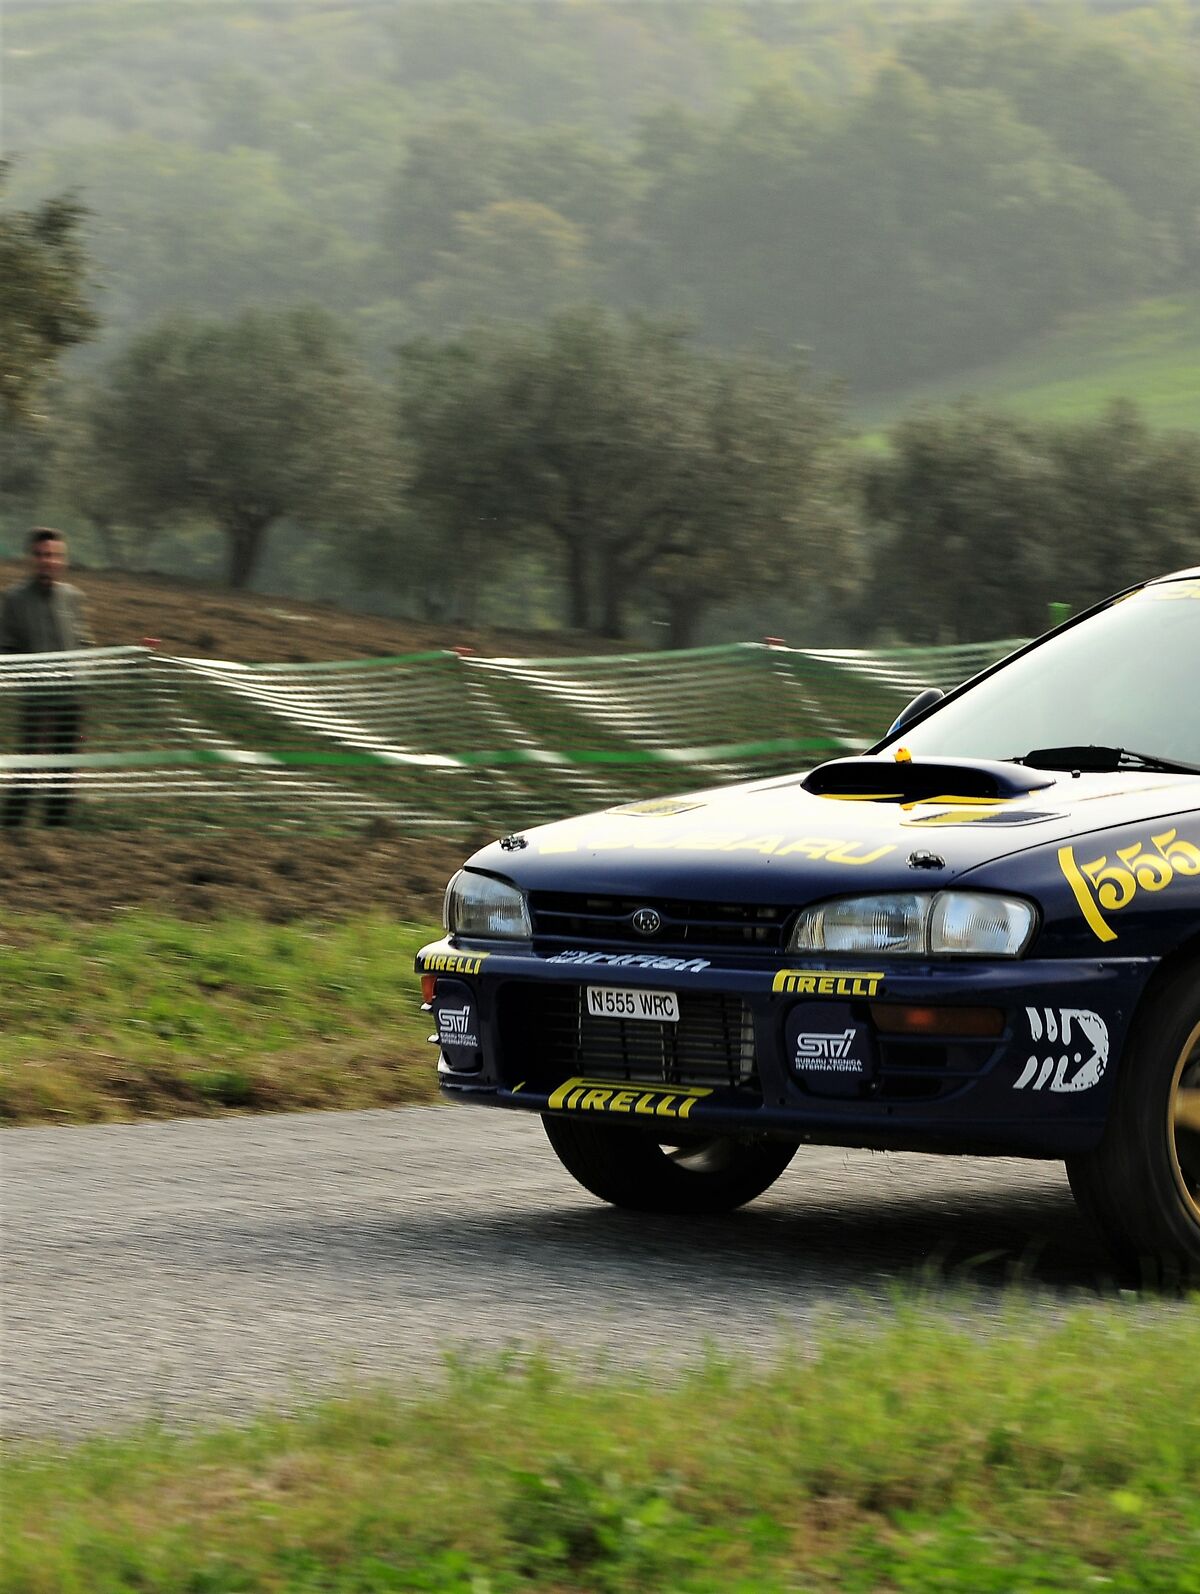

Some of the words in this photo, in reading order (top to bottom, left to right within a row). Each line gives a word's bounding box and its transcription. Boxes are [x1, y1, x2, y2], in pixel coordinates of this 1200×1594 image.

[772, 969, 885, 996] PIRELLI
[640, 993, 674, 1017] WRC
[548, 1077, 714, 1118] PIRELLI
